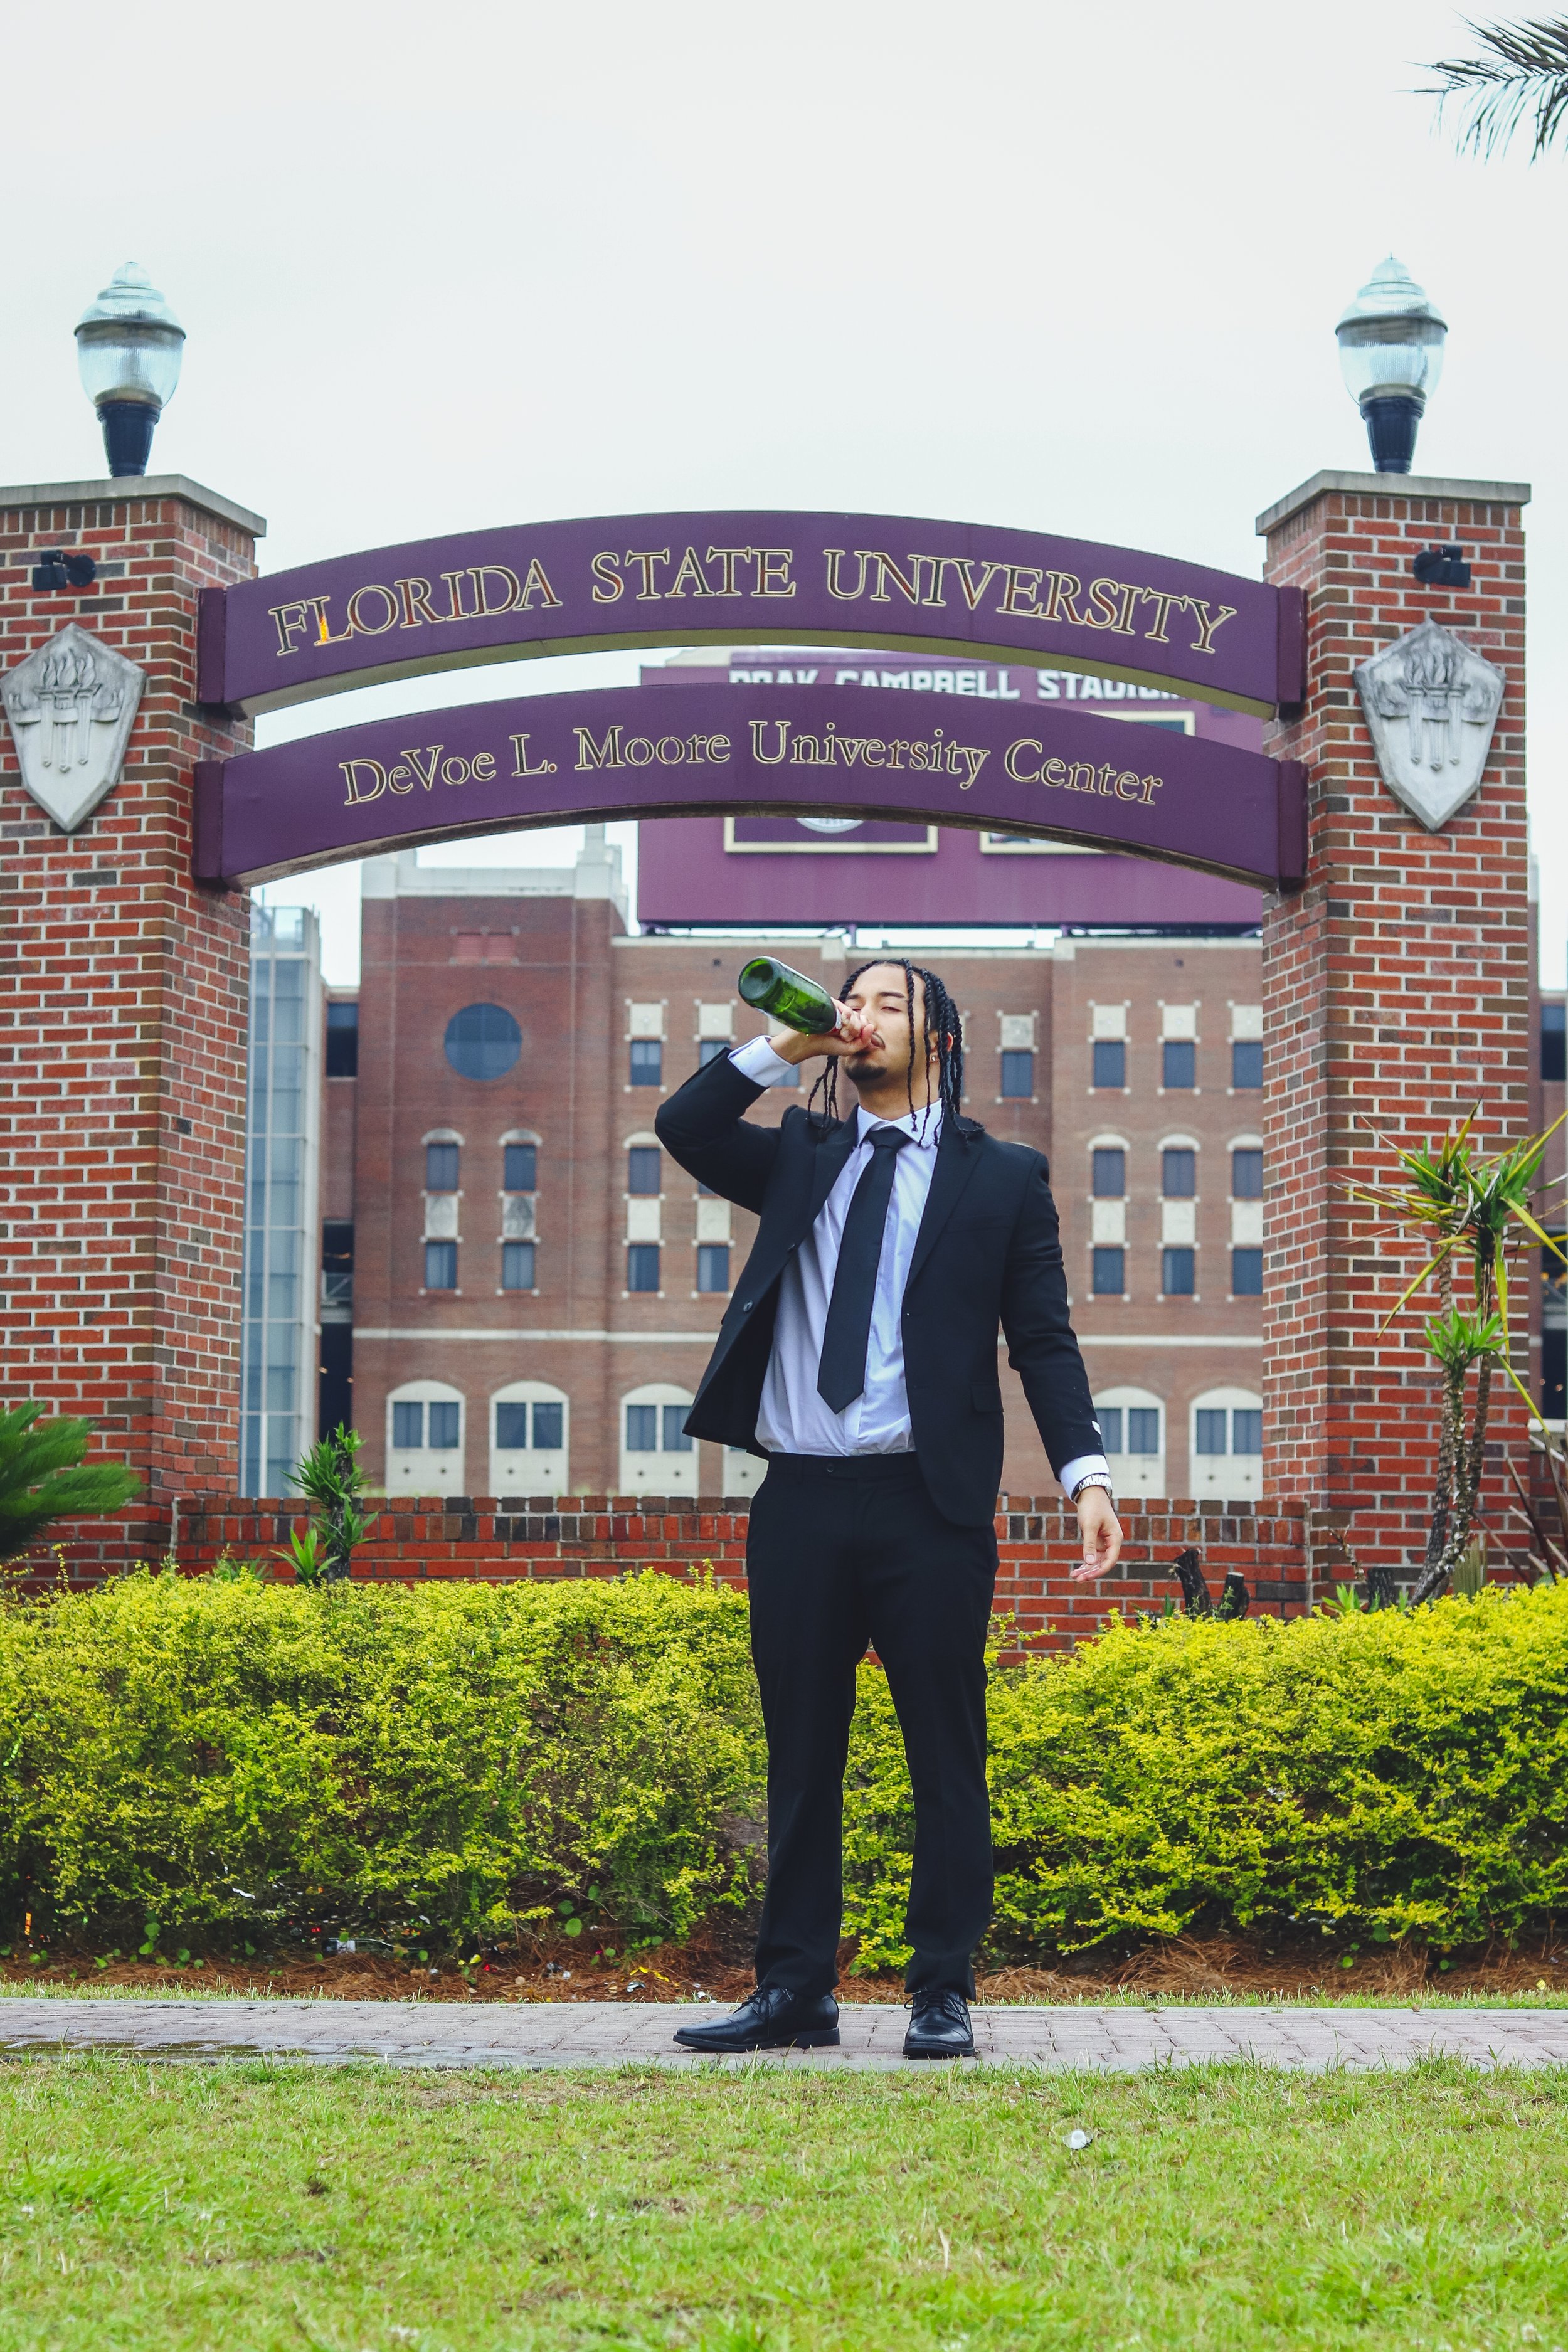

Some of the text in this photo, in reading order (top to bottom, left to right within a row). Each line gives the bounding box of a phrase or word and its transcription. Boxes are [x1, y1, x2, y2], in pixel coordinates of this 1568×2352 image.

[268, 546, 1237, 657] FLORIDA STATE UNIVERSITY
[1036, 669, 1187, 701] STADI
[339, 721, 1163, 805] DeVoe L. Moore University Center
